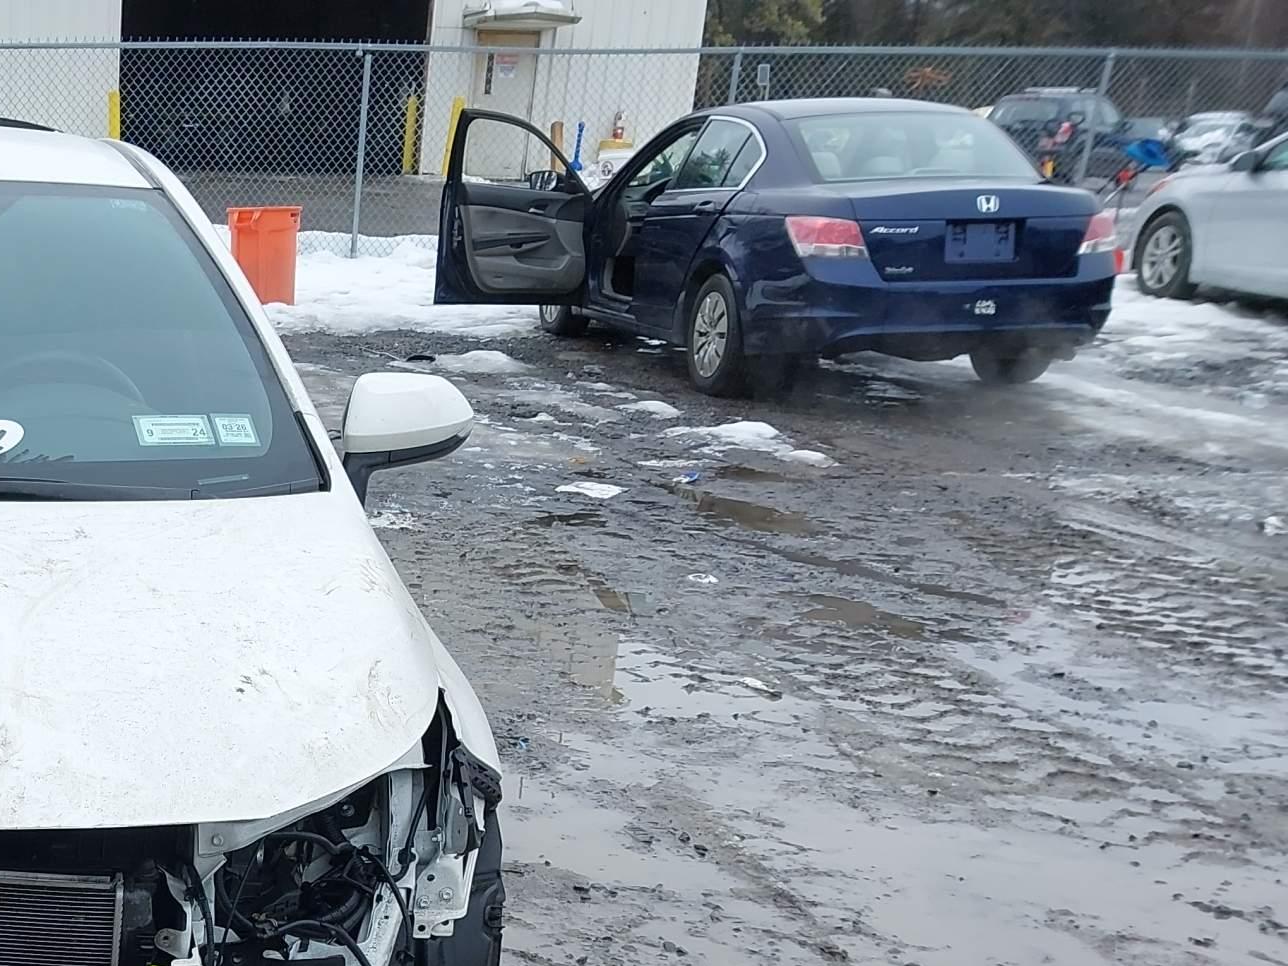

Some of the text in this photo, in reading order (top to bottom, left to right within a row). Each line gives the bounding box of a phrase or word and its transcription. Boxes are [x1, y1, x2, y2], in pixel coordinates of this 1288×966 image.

[869, 226, 920, 234] Accord
[146, 429, 154, 437] 9
[191, 428, 206, 437] 24
